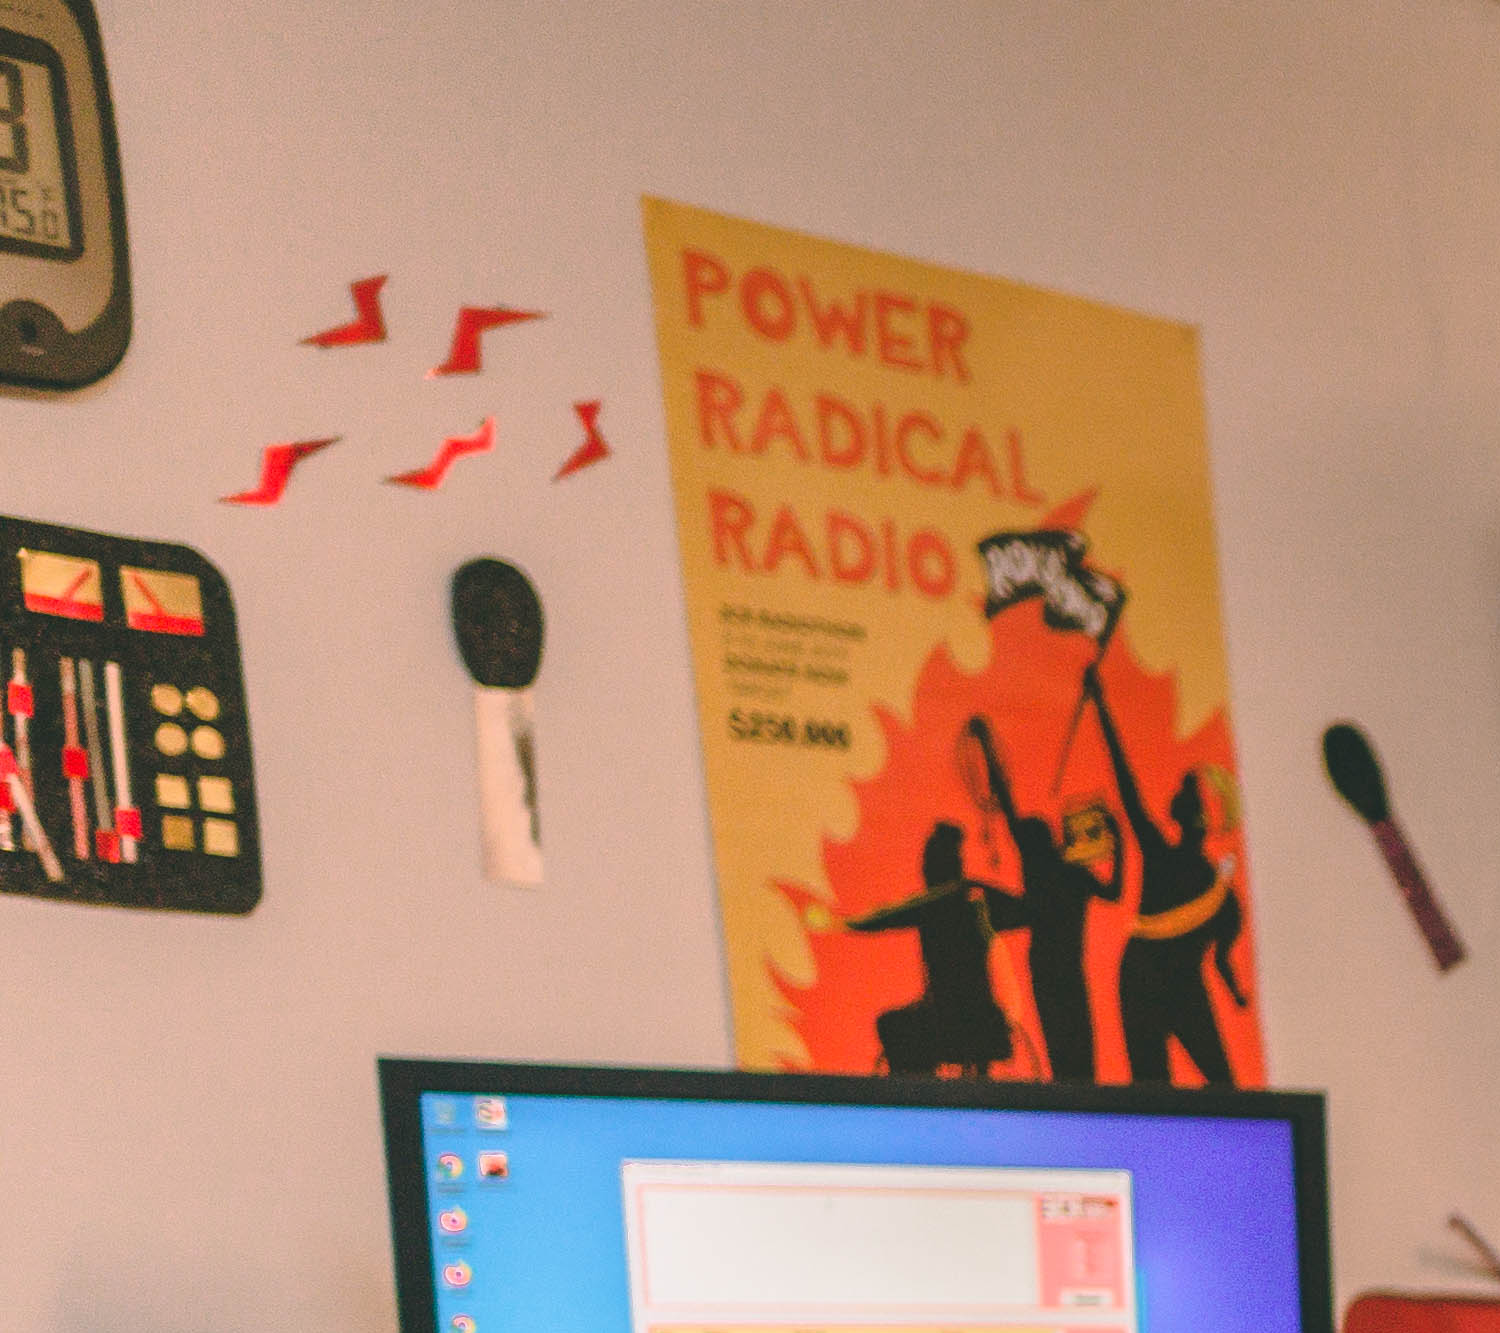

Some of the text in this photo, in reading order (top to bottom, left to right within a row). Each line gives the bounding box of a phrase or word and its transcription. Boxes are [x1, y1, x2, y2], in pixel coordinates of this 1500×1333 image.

[681, 248, 971, 382] POWER
[695, 369, 1045, 508] RADICAL
[707, 488, 956, 597] RADIO
